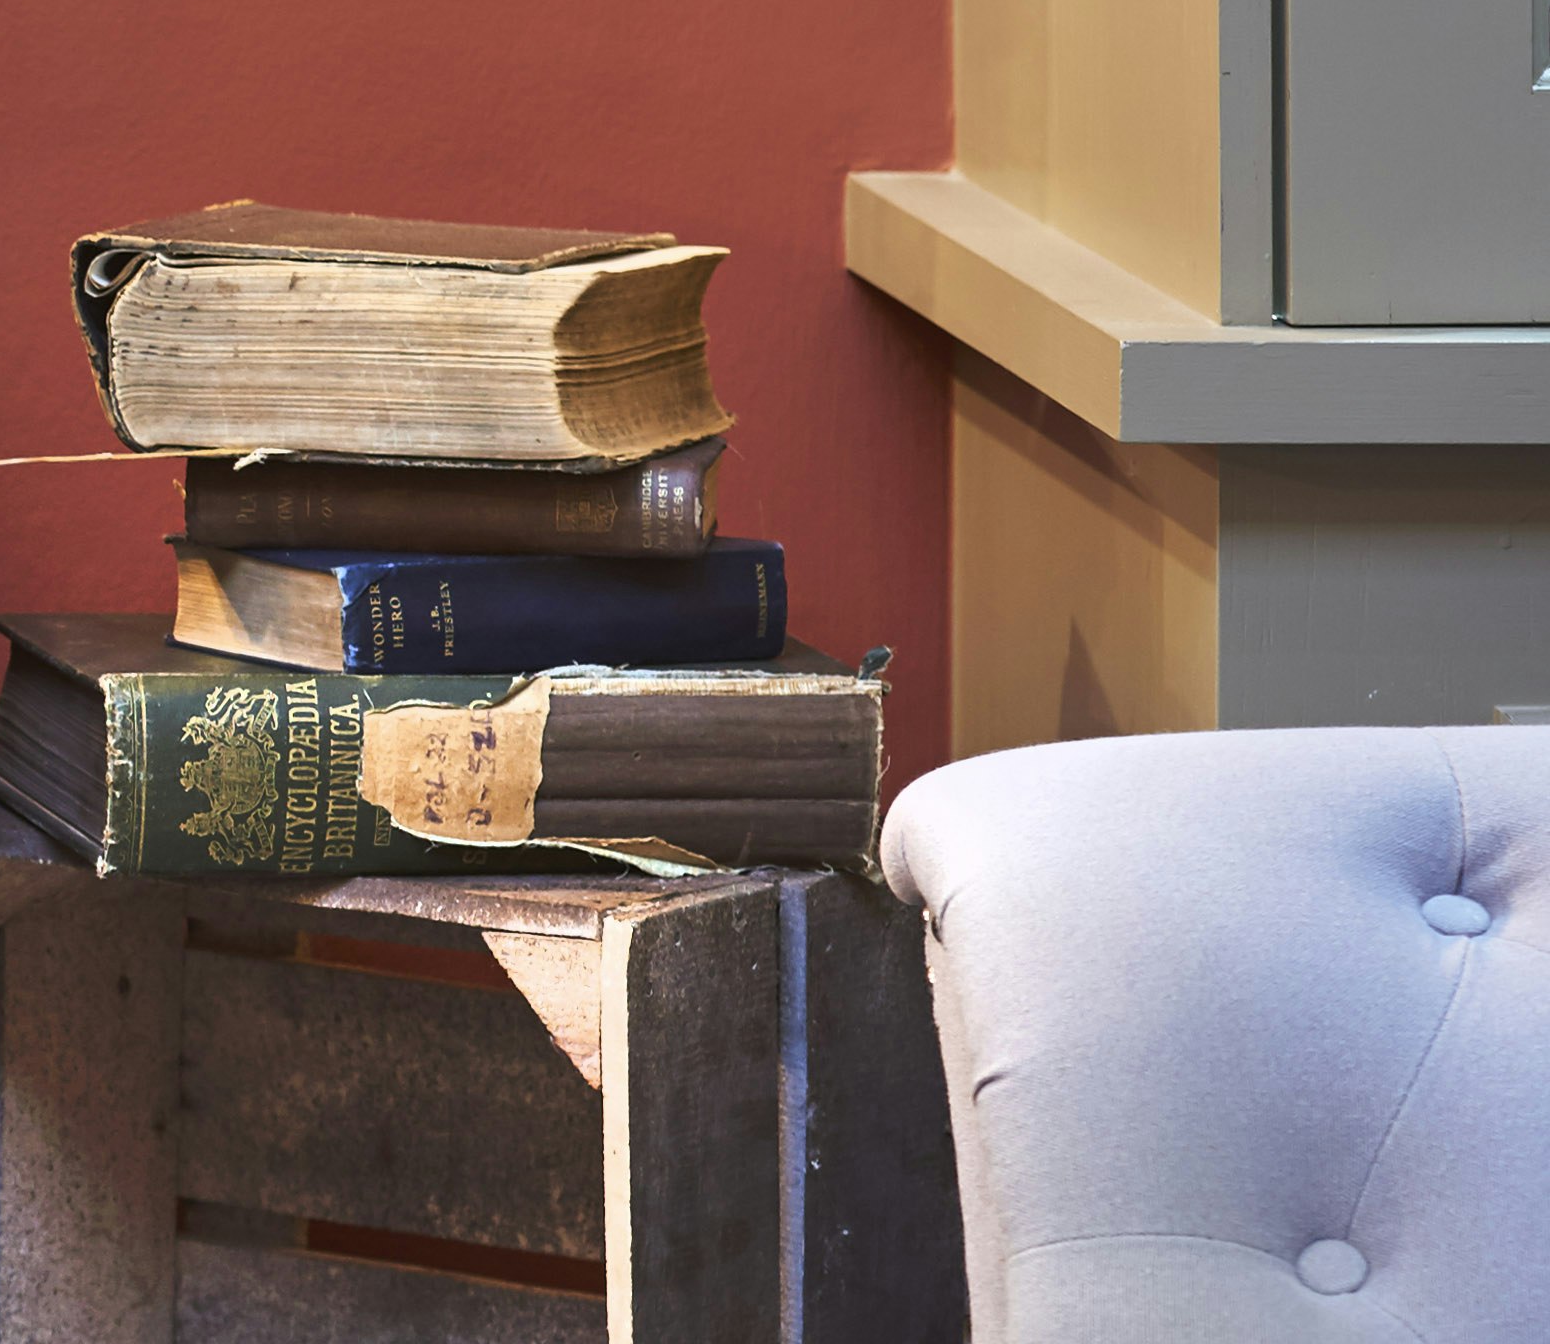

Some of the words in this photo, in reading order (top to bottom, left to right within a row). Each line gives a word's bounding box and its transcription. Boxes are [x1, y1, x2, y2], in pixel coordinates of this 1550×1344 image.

[641, 469, 653, 549] CAMBRIDGE
[371, 582, 384, 664] WONDER
[390, 596, 405, 649] HERO
[443, 579, 455, 657] PRIESTLEY
[323, 693, 362, 859] BRITANNICA.
